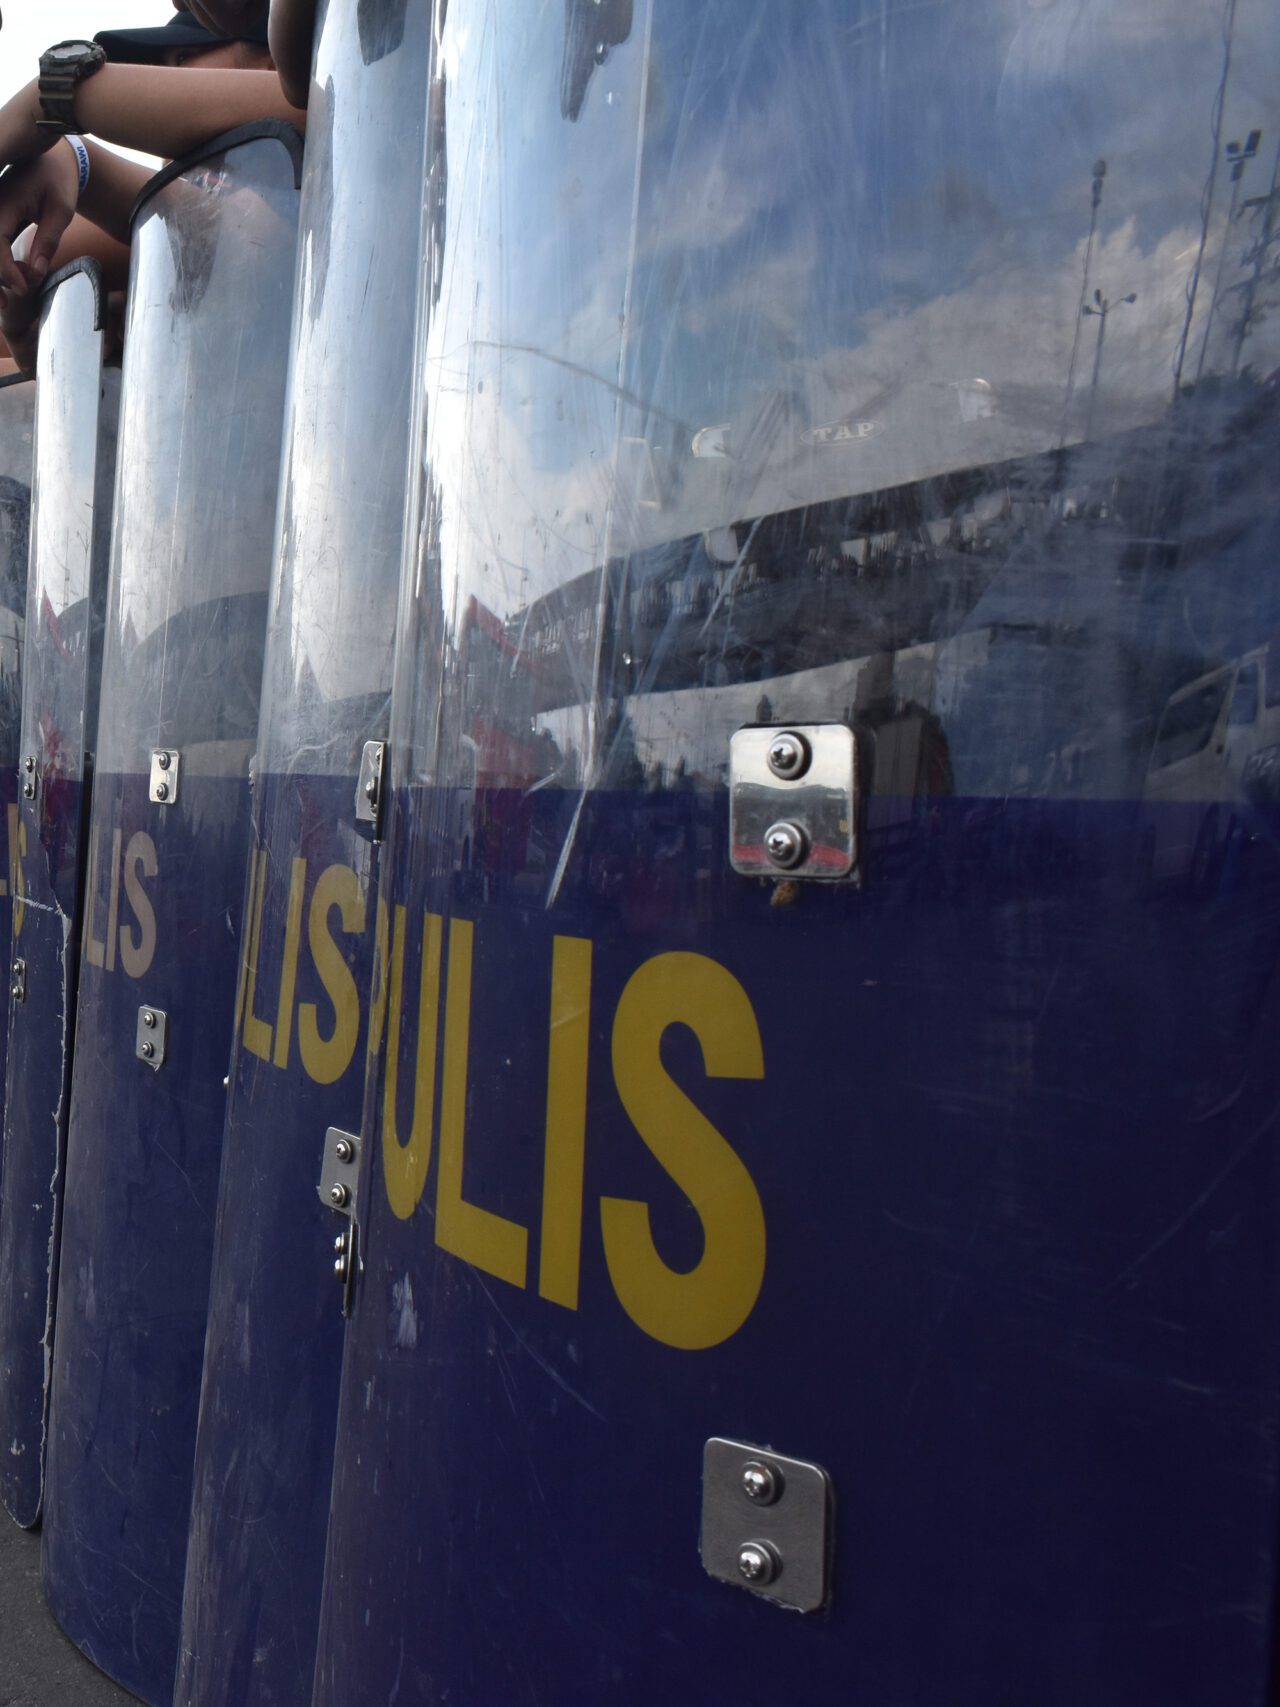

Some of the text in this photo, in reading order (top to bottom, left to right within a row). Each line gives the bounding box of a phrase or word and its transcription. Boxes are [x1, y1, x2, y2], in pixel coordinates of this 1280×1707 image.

[814, 422, 875, 442] TAP
[84, 825, 159, 979] LIS
[235, 848, 367, 1085] LIS
